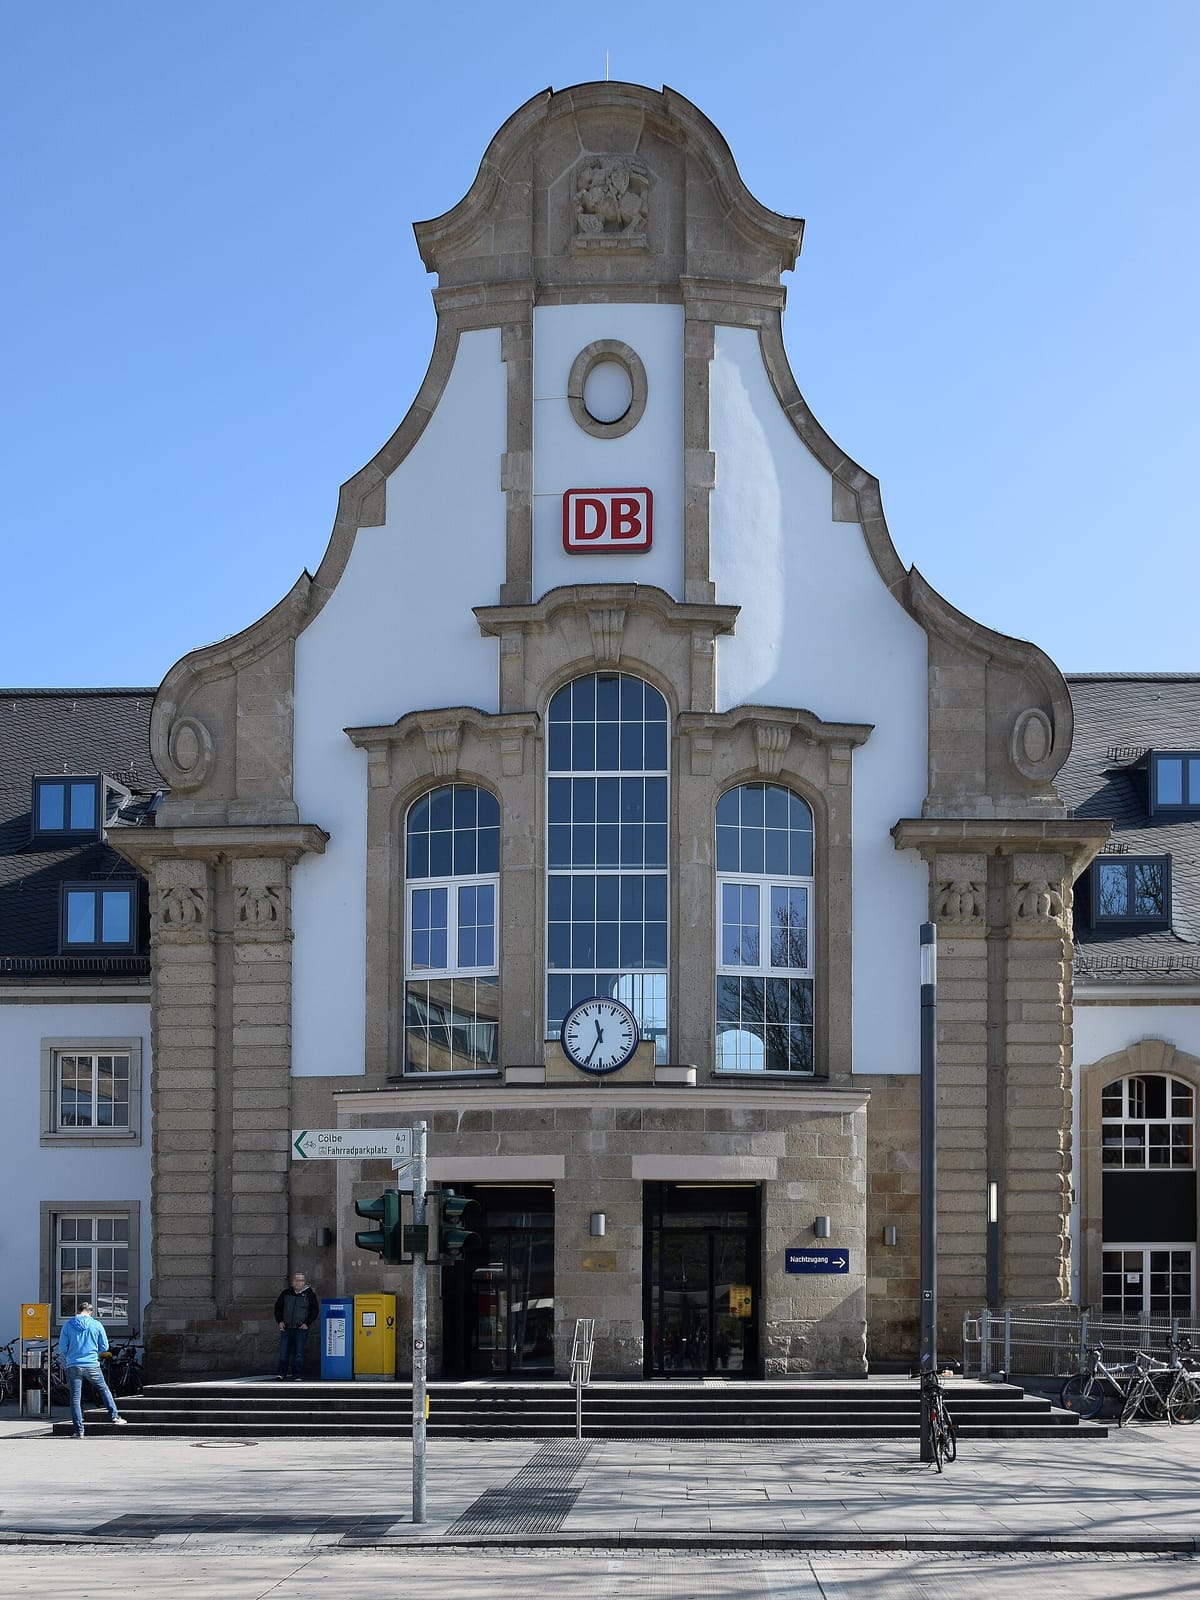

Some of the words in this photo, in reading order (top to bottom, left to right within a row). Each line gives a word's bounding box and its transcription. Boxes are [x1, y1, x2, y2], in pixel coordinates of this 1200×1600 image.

[575, 498, 641, 541] DB
[318, 1133, 343, 1143] Cölbe
[327, 1145, 388, 1156] Fahrradparkplatz
[790, 1256, 829, 1264] Nachtzugang
